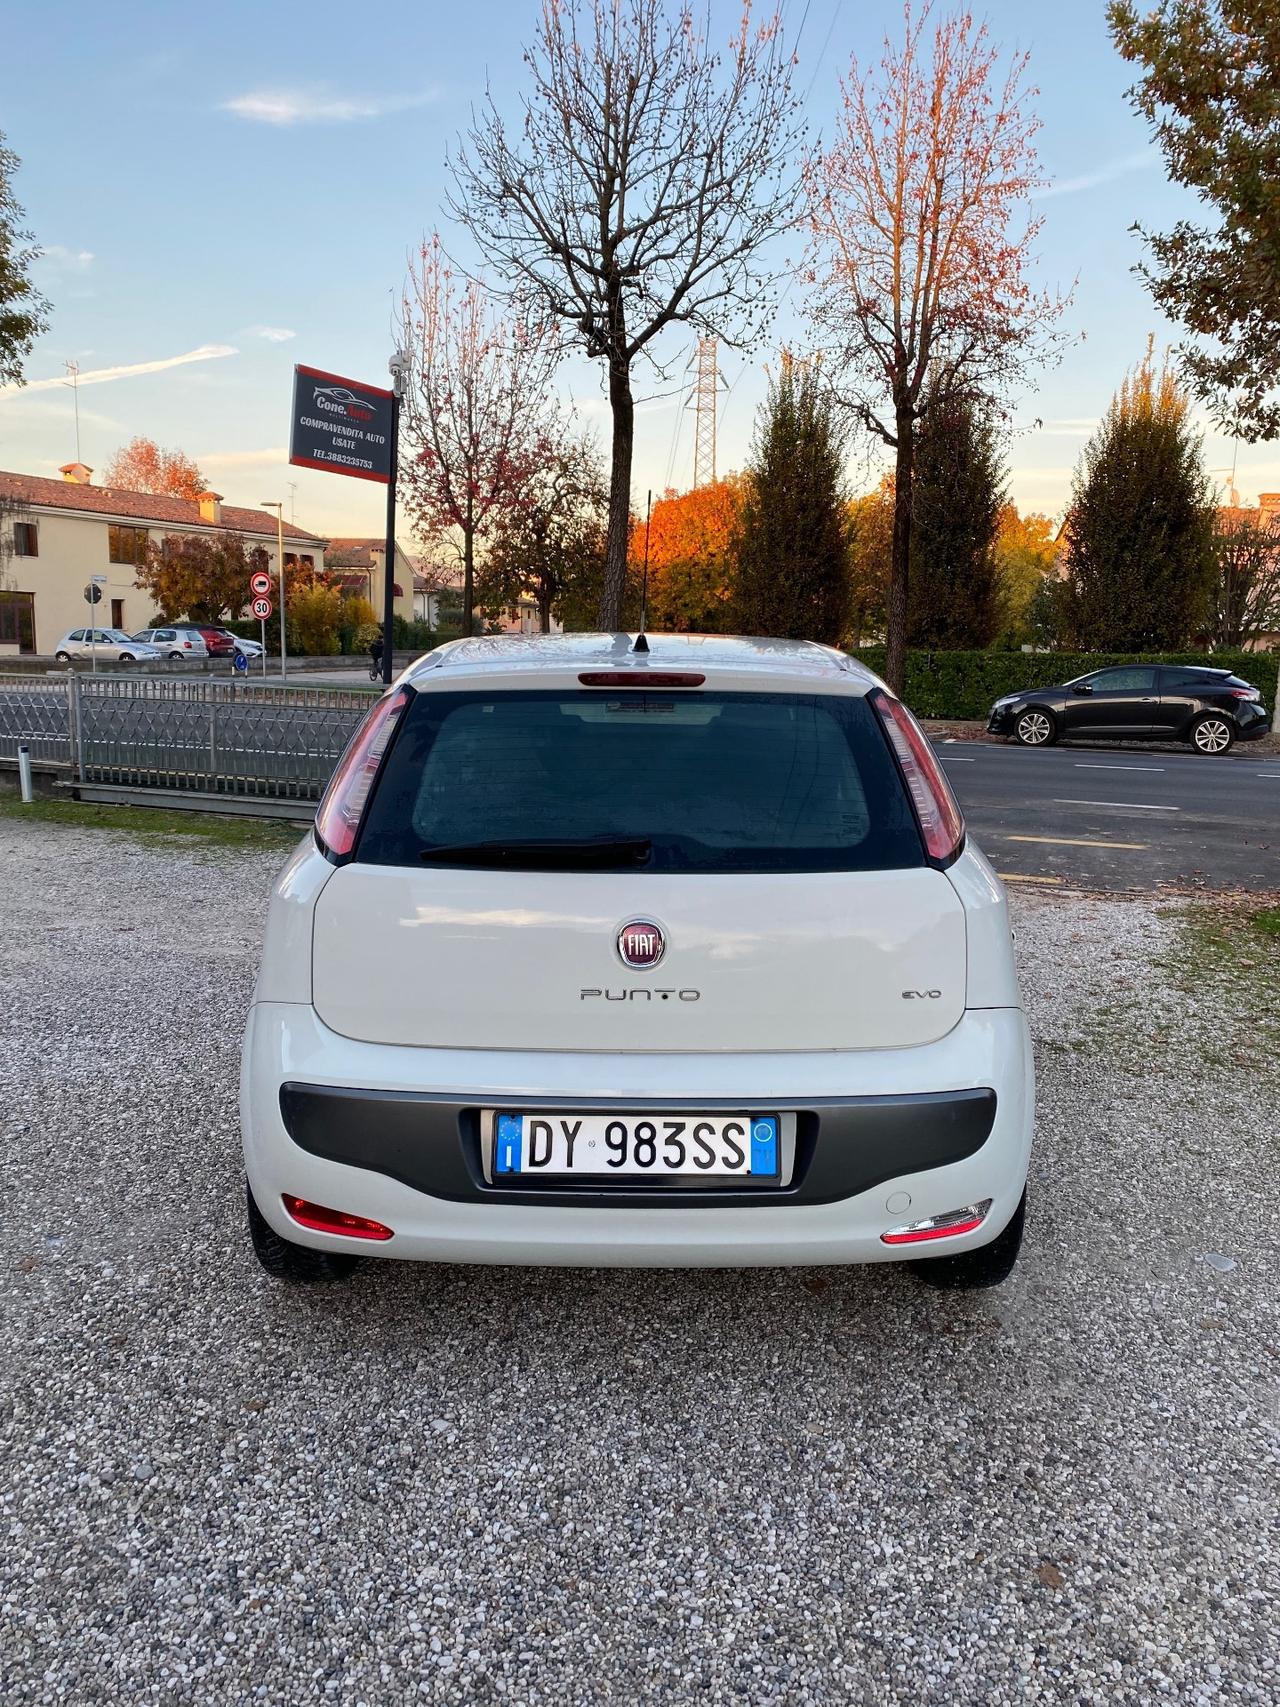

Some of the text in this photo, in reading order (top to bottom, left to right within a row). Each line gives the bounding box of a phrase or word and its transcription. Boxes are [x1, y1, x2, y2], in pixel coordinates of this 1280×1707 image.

[300, 416, 364, 440] COMPRAVENDITA
[365, 433, 385, 444] AUTO
[332, 437, 356, 450] USATE
[256, 602, 267, 613] 30
[627, 933, 656, 956] FIAT
[580, 988, 701, 1001] PUNTO
[902, 990, 942, 999] EVO
[528, 1120, 583, 1168] DY
[605, 1121, 745, 1169] 983SS
